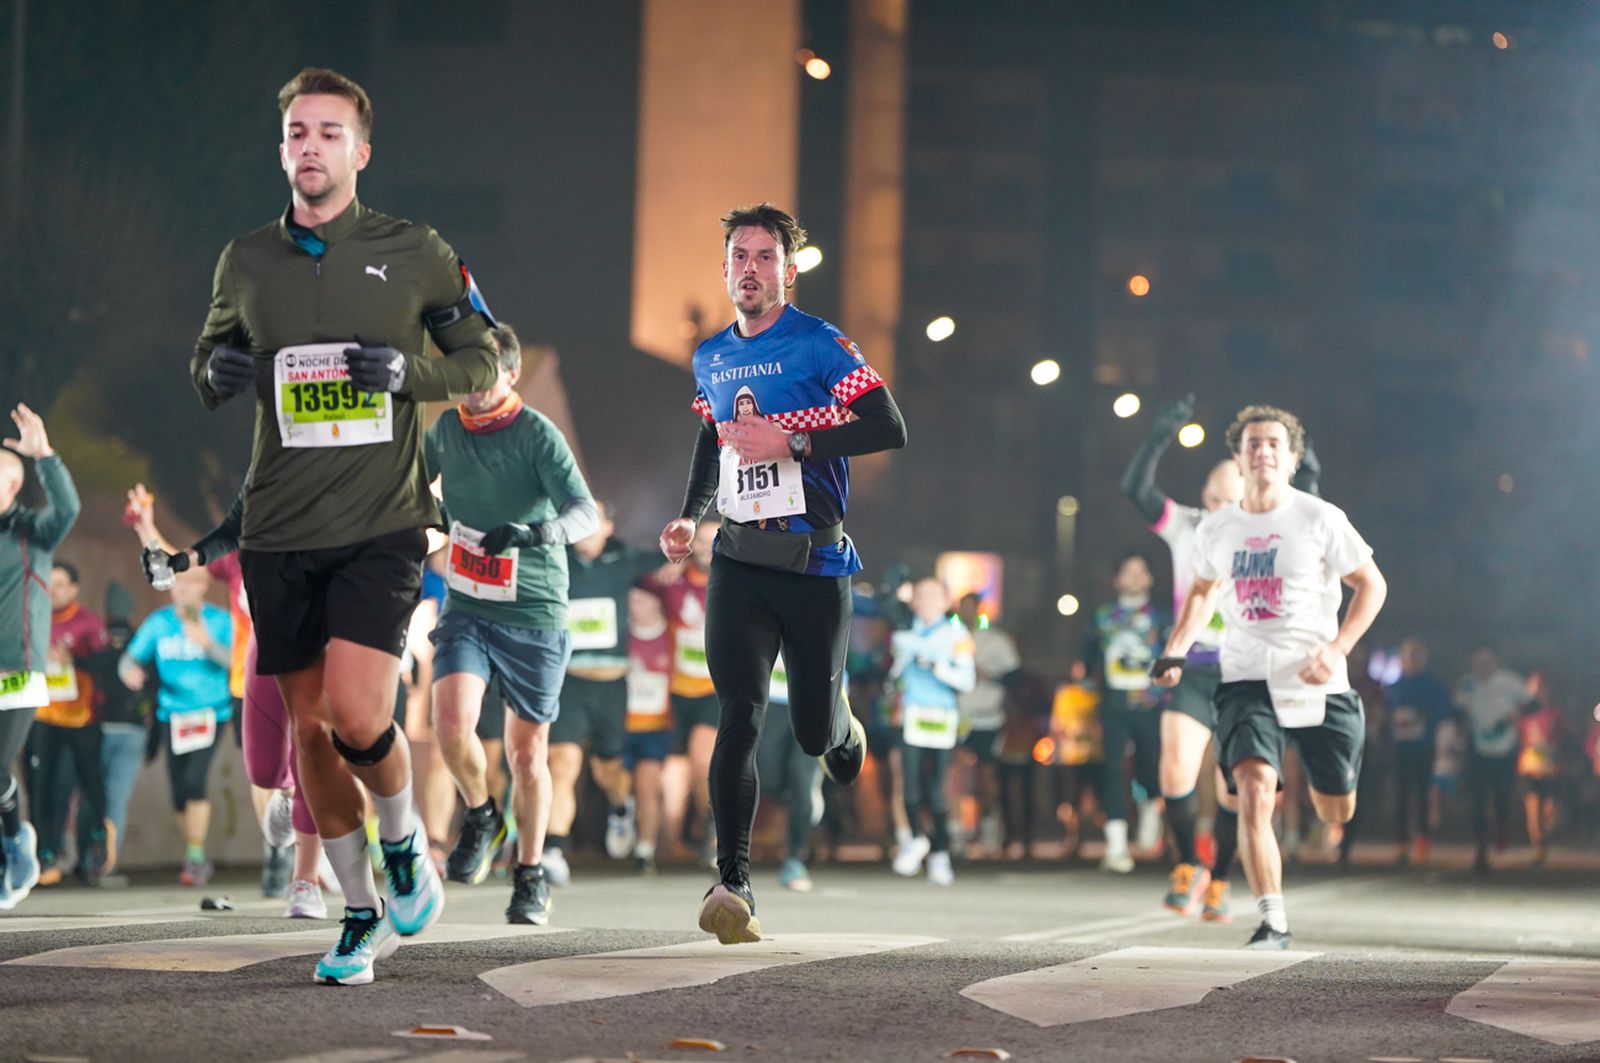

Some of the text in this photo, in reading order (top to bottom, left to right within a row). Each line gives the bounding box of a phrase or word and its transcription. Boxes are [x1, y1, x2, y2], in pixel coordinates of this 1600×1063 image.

[299, 356, 330, 368] NOCHE
[288, 371, 307, 382] SAN
[711, 362, 782, 385] BASTITANIA
[289, 381, 377, 413] 13592
[740, 490, 772, 501] ALEJANDRO
